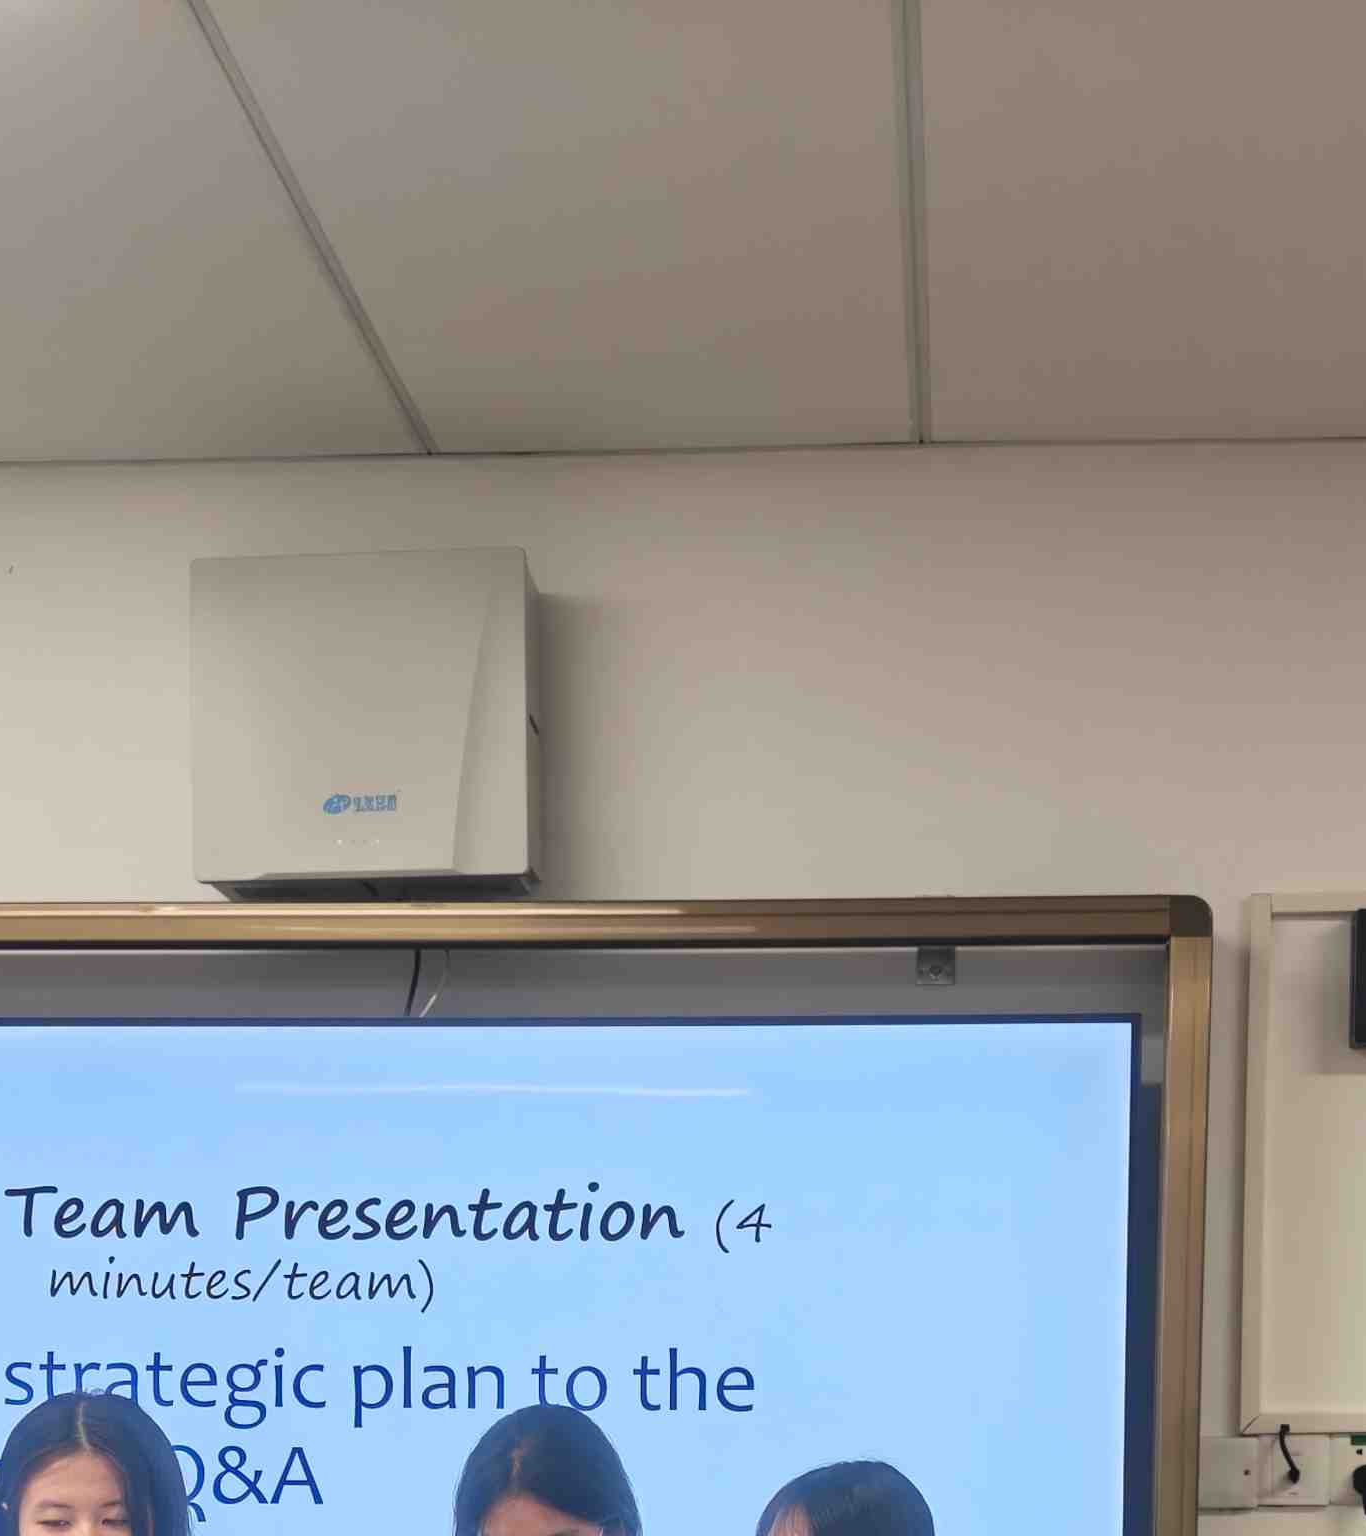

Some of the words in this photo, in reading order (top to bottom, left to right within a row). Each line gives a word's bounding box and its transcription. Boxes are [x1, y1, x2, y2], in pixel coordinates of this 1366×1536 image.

[4, 1186, 199, 1239] Team
[235, 1182, 685, 1242] Presentation
[716, 1199, 772, 1253] (4
[50, 1256, 435, 1314] minutes/team)
[4, 1347, 326, 1429] strategic
[353, 1346, 506, 1429] plan
[532, 1355, 608, 1411] to
[633, 1347, 755, 1412] the
